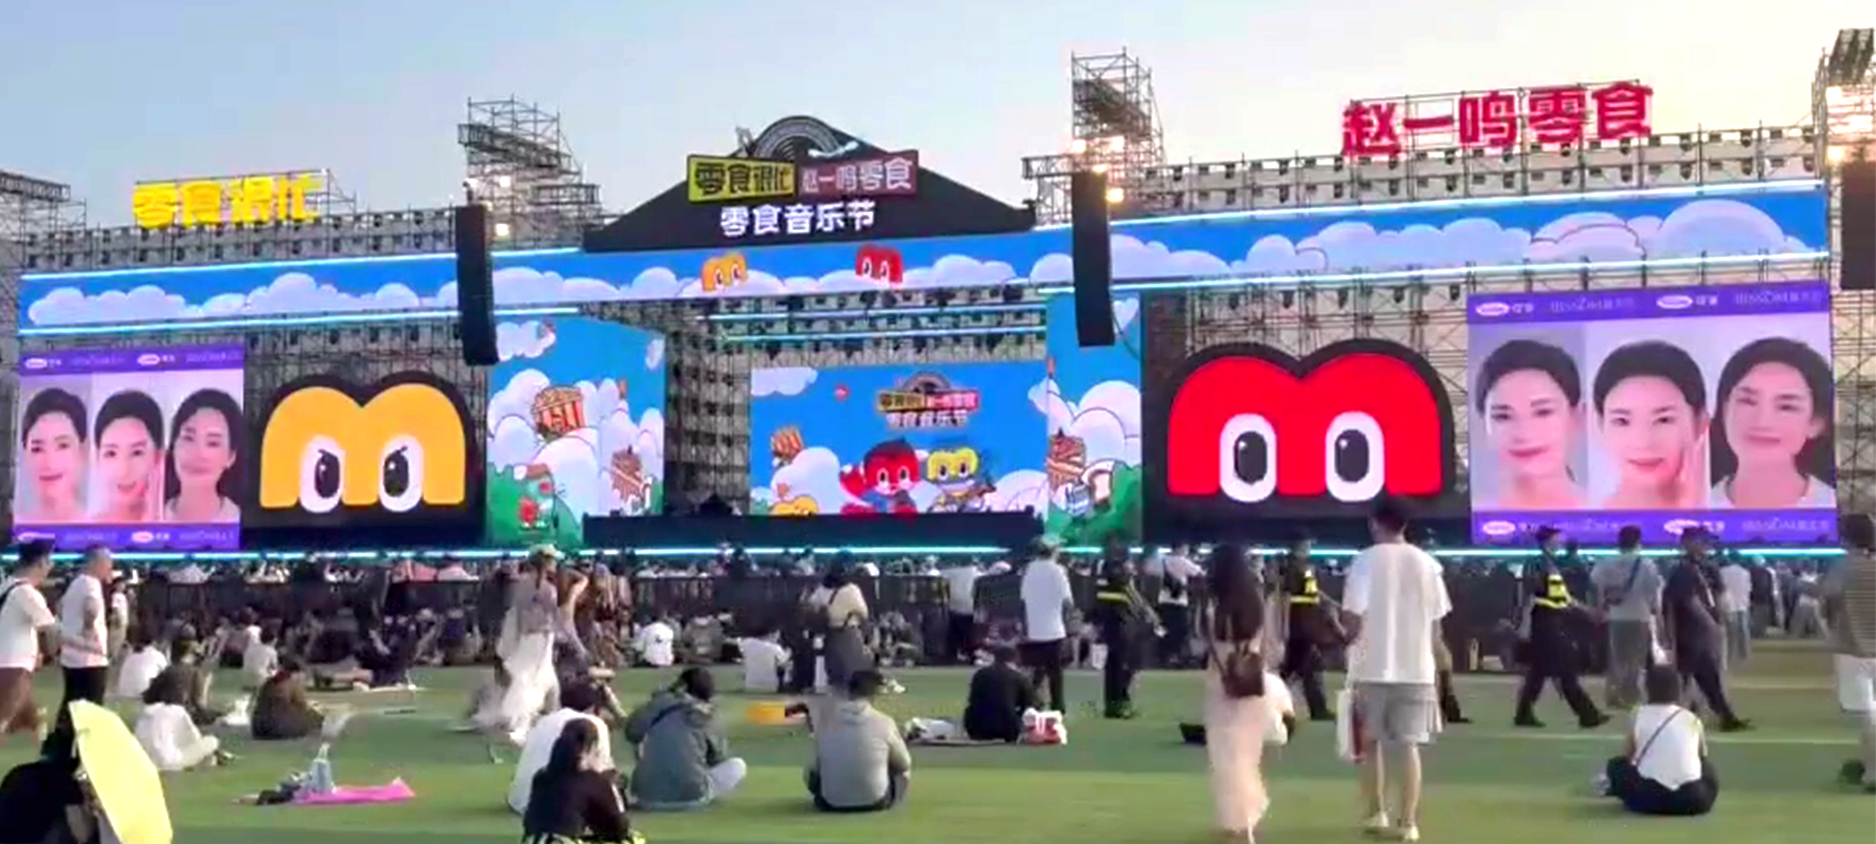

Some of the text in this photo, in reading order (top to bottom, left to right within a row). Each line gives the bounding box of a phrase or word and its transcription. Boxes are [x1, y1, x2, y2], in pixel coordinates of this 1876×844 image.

[1342, 83, 1653, 157] 赵一鸣零食
[802, 158, 913, 194] 赵一鸣零食
[720, 200, 877, 237] 零食音乐节
